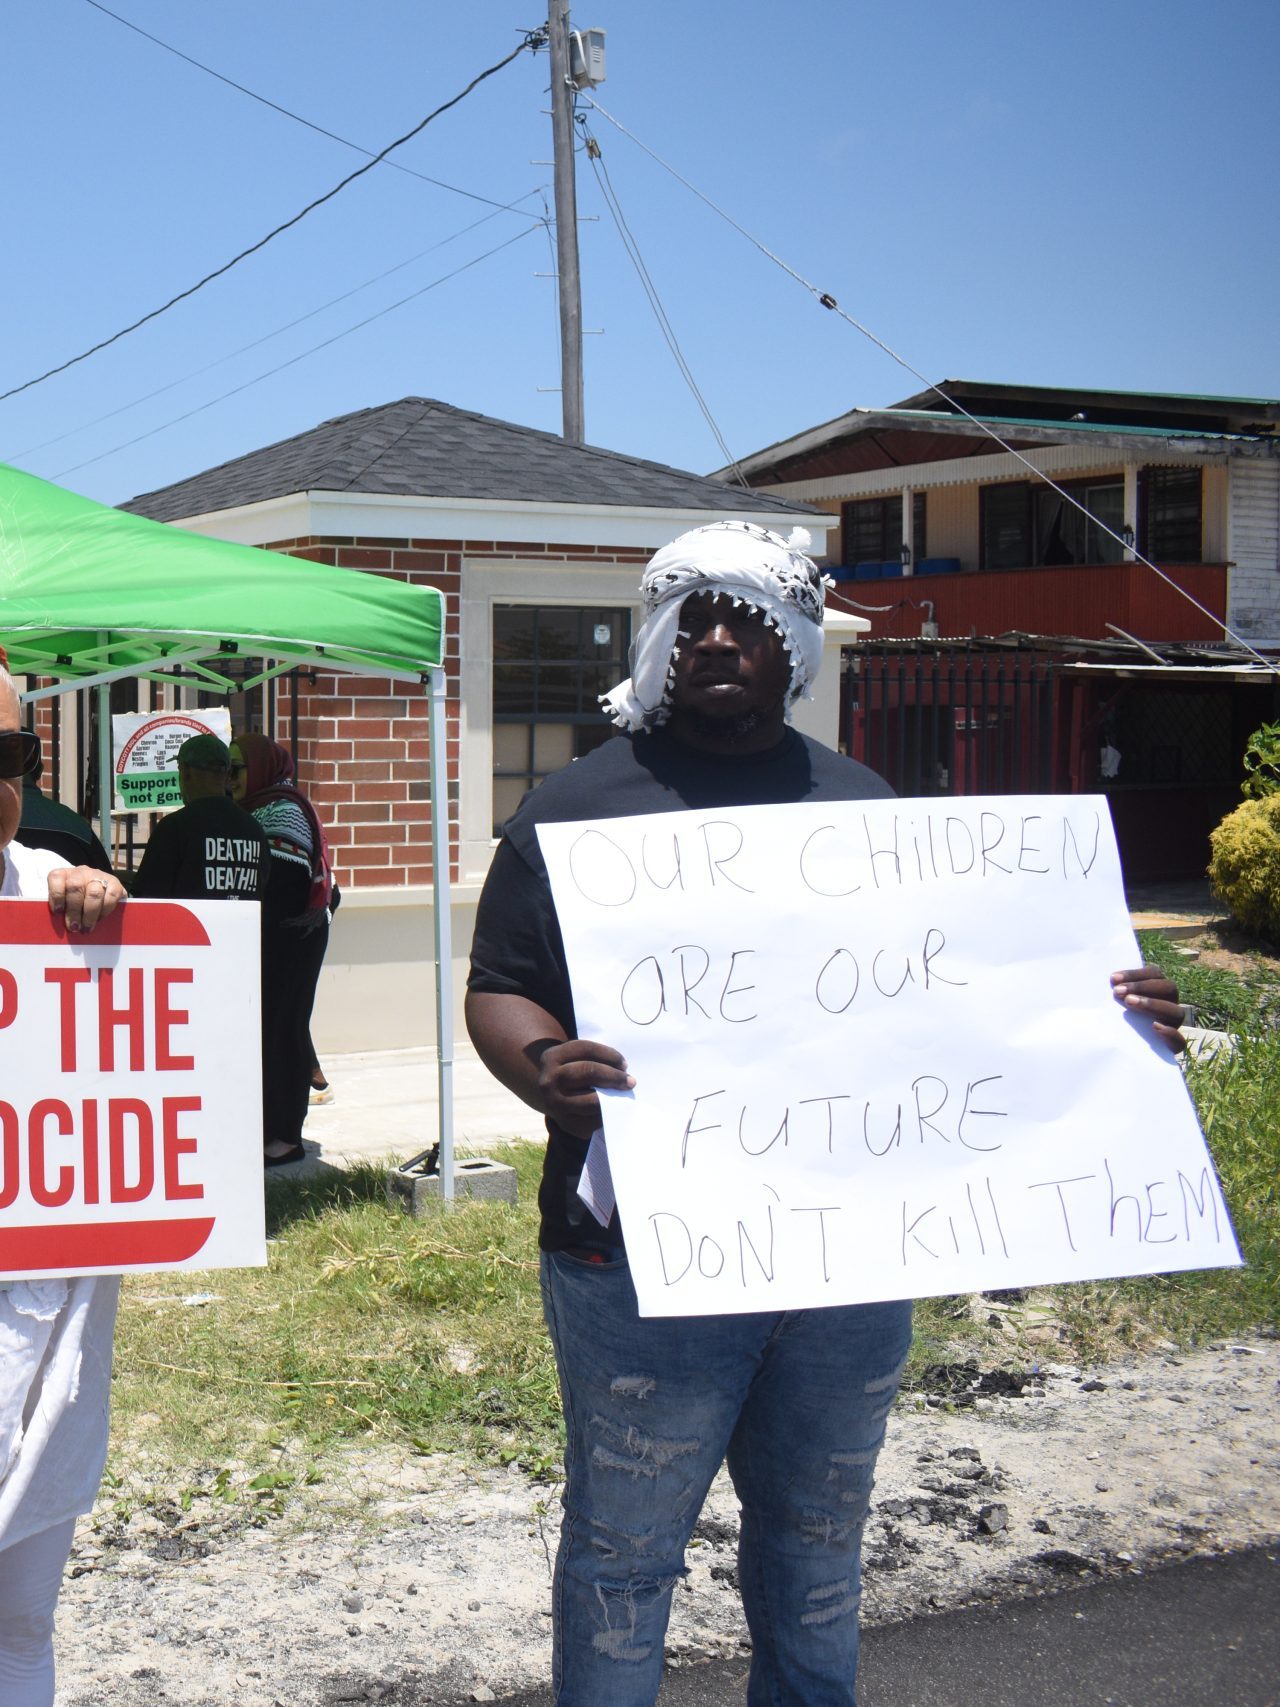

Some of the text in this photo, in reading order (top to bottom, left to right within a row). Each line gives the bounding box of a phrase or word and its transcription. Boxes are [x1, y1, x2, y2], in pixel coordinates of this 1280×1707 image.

[121, 776, 177, 791] Support
[129, 792, 152, 803] not
[205, 837, 260, 863] DEATH!!
[569, 820, 755, 907] OUR
[205, 866, 258, 892] DEATH!!
[815, 928, 968, 1014] OUR
[44, 967, 194, 1072] THE
[682, 1075, 1008, 1168] FUTURE
